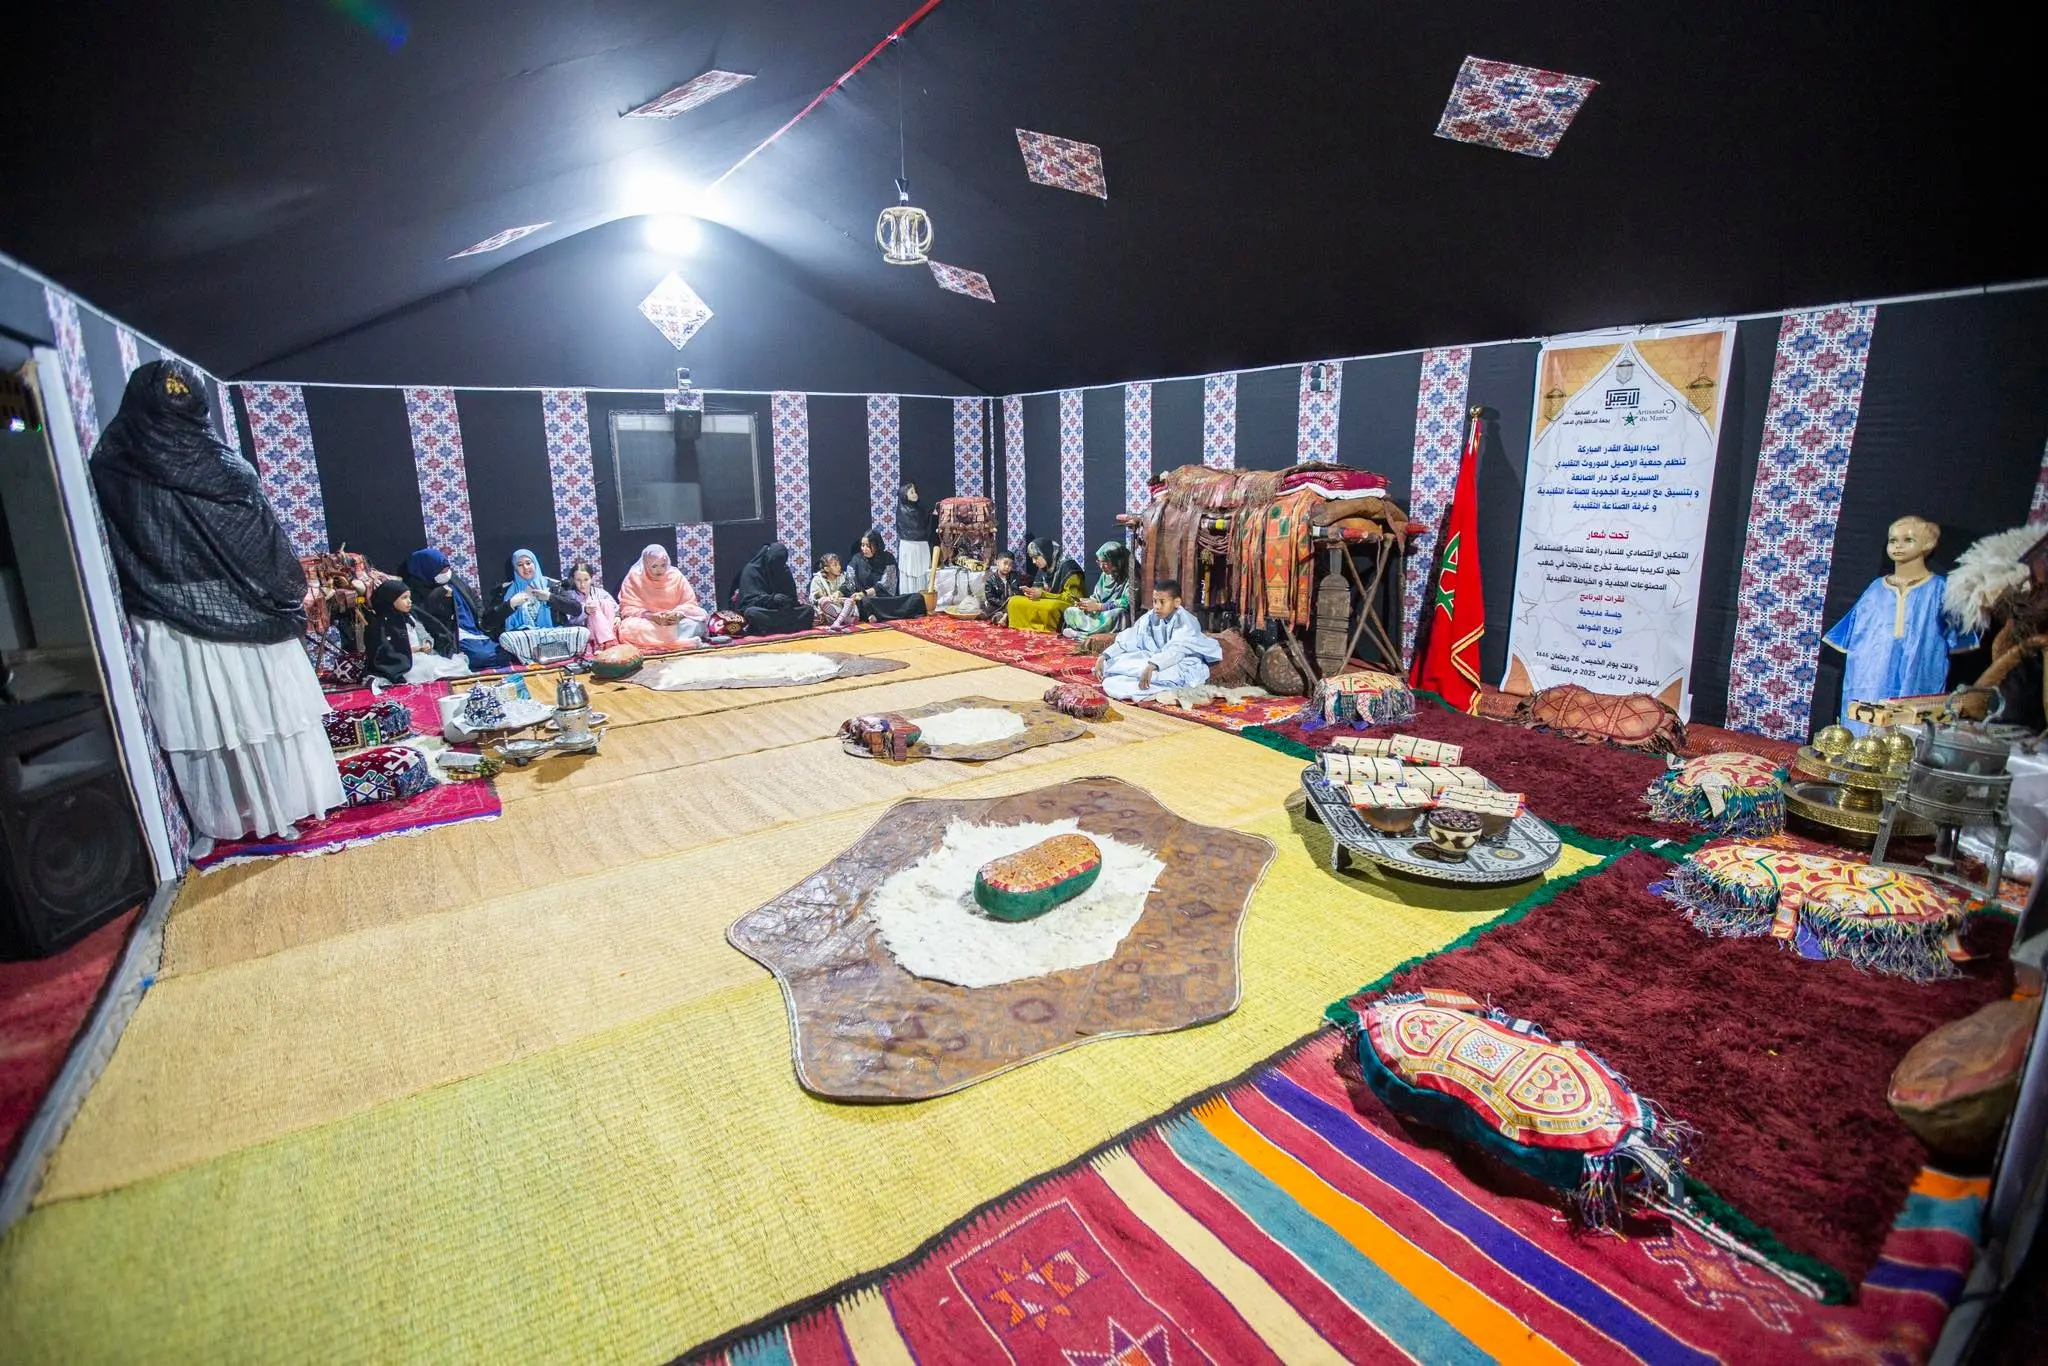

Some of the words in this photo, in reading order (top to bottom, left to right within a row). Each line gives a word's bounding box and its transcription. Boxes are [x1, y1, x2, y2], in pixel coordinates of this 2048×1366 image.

[1578, 445, 1601, 454] المباركة
[1604, 444, 1621, 454] القدر
[1639, 458, 1662, 468] جمعية
[1664, 458, 1686, 468] تنظم
[1597, 474, 1607, 482] دار
[1610, 474, 1630, 482] لمركز
[1632, 474, 1659, 482] المسيرة
[1537, 487, 1565, 495] التقليدية
[1591, 488, 1619, 497] الجهوية
[1621, 488, 1651, 497] المديرية
[1652, 488, 1662, 498] مع
[1665, 488, 1692, 497] بتنسيق
[1572, 502, 1600, 510] التقليدية
[1586, 530, 1605, 540] شعار
[1609, 531, 1629, 539] تحت
[1604, 611, 1622, 619] جلسة
[1604, 626, 1622, 635] توزيع
[1582, 639, 1596, 648] شاي
[1606, 661, 1618, 670] يوم
[1580, 669, 1596, 677] 2025
